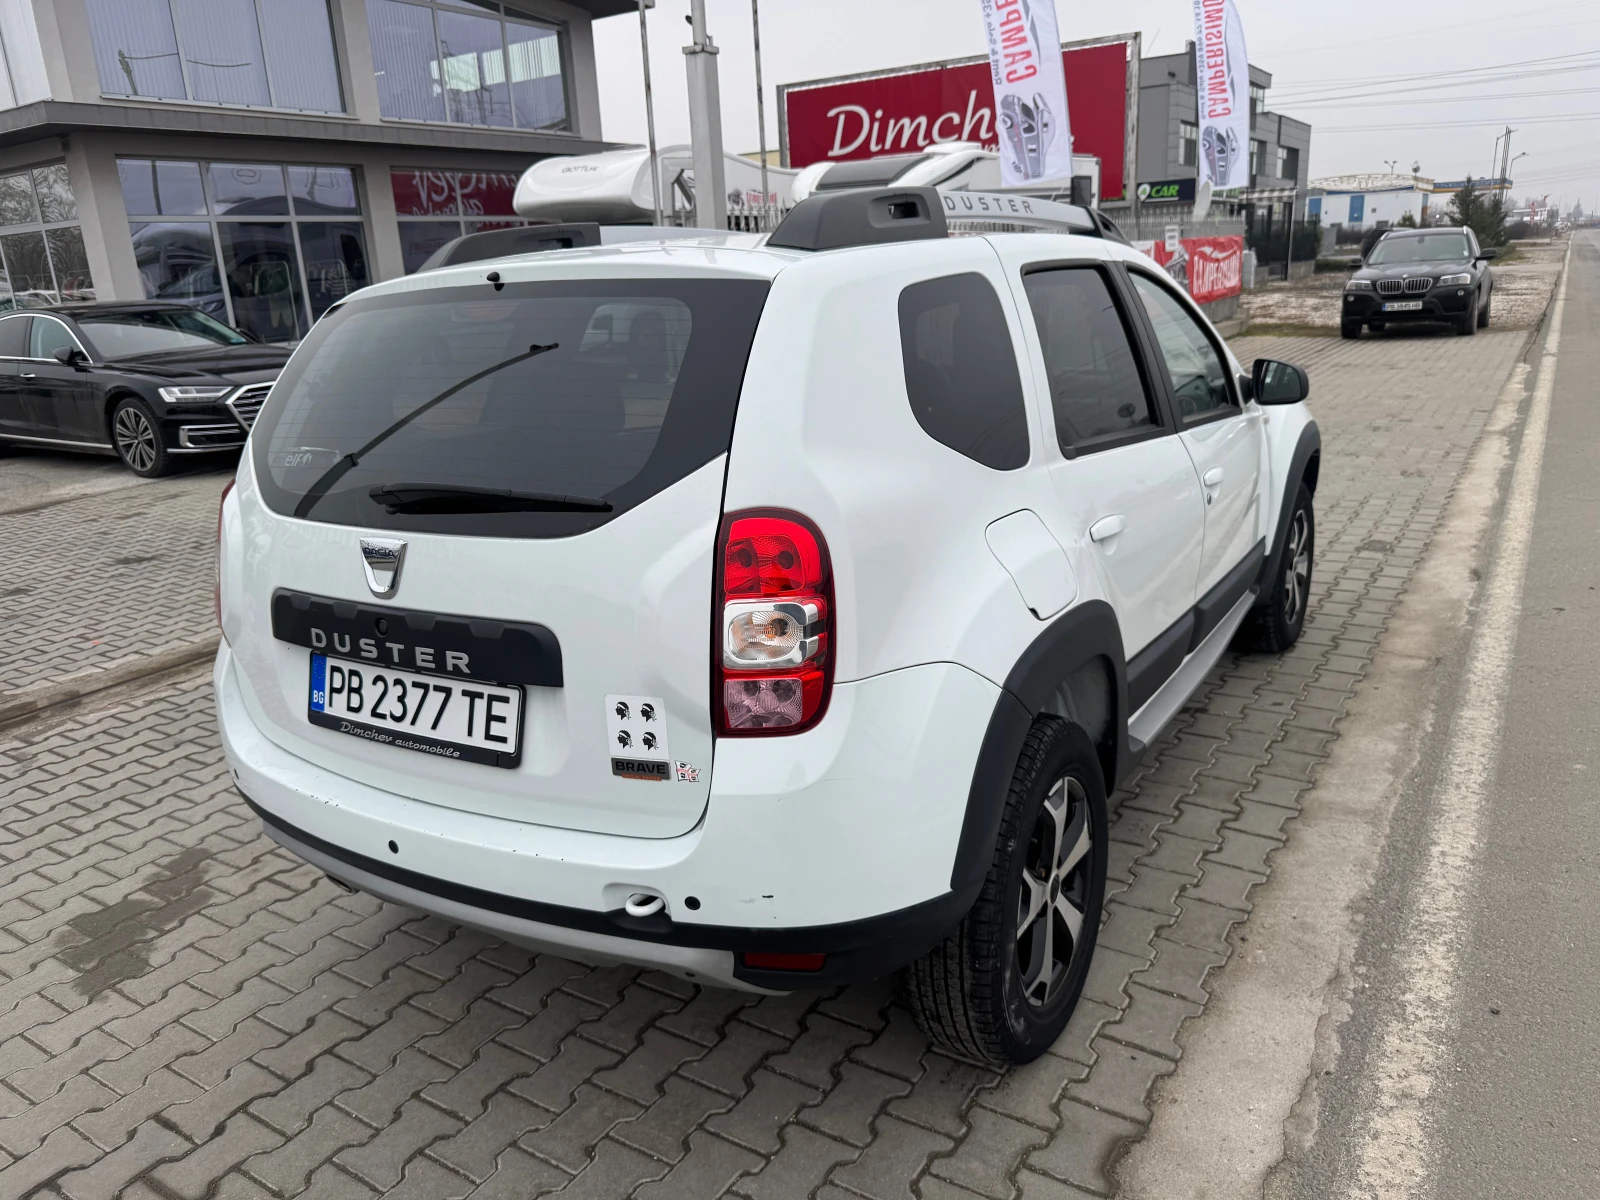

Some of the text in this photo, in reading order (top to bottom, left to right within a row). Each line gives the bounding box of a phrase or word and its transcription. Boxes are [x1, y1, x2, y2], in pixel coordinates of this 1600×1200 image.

[1151, 184, 1179, 197] CAR
[943, 196, 1034, 214] DUSTER
[284, 453, 303, 467] elf
[363, 547, 395, 559] DACIA
[311, 627, 471, 674] DUSTER
[313, 690, 325, 705] BG
[328, 664, 511, 744] PB 2377 TE
[339, 720, 461, 758] Dimchev automobile
[615, 761, 666, 775] BRAVE
